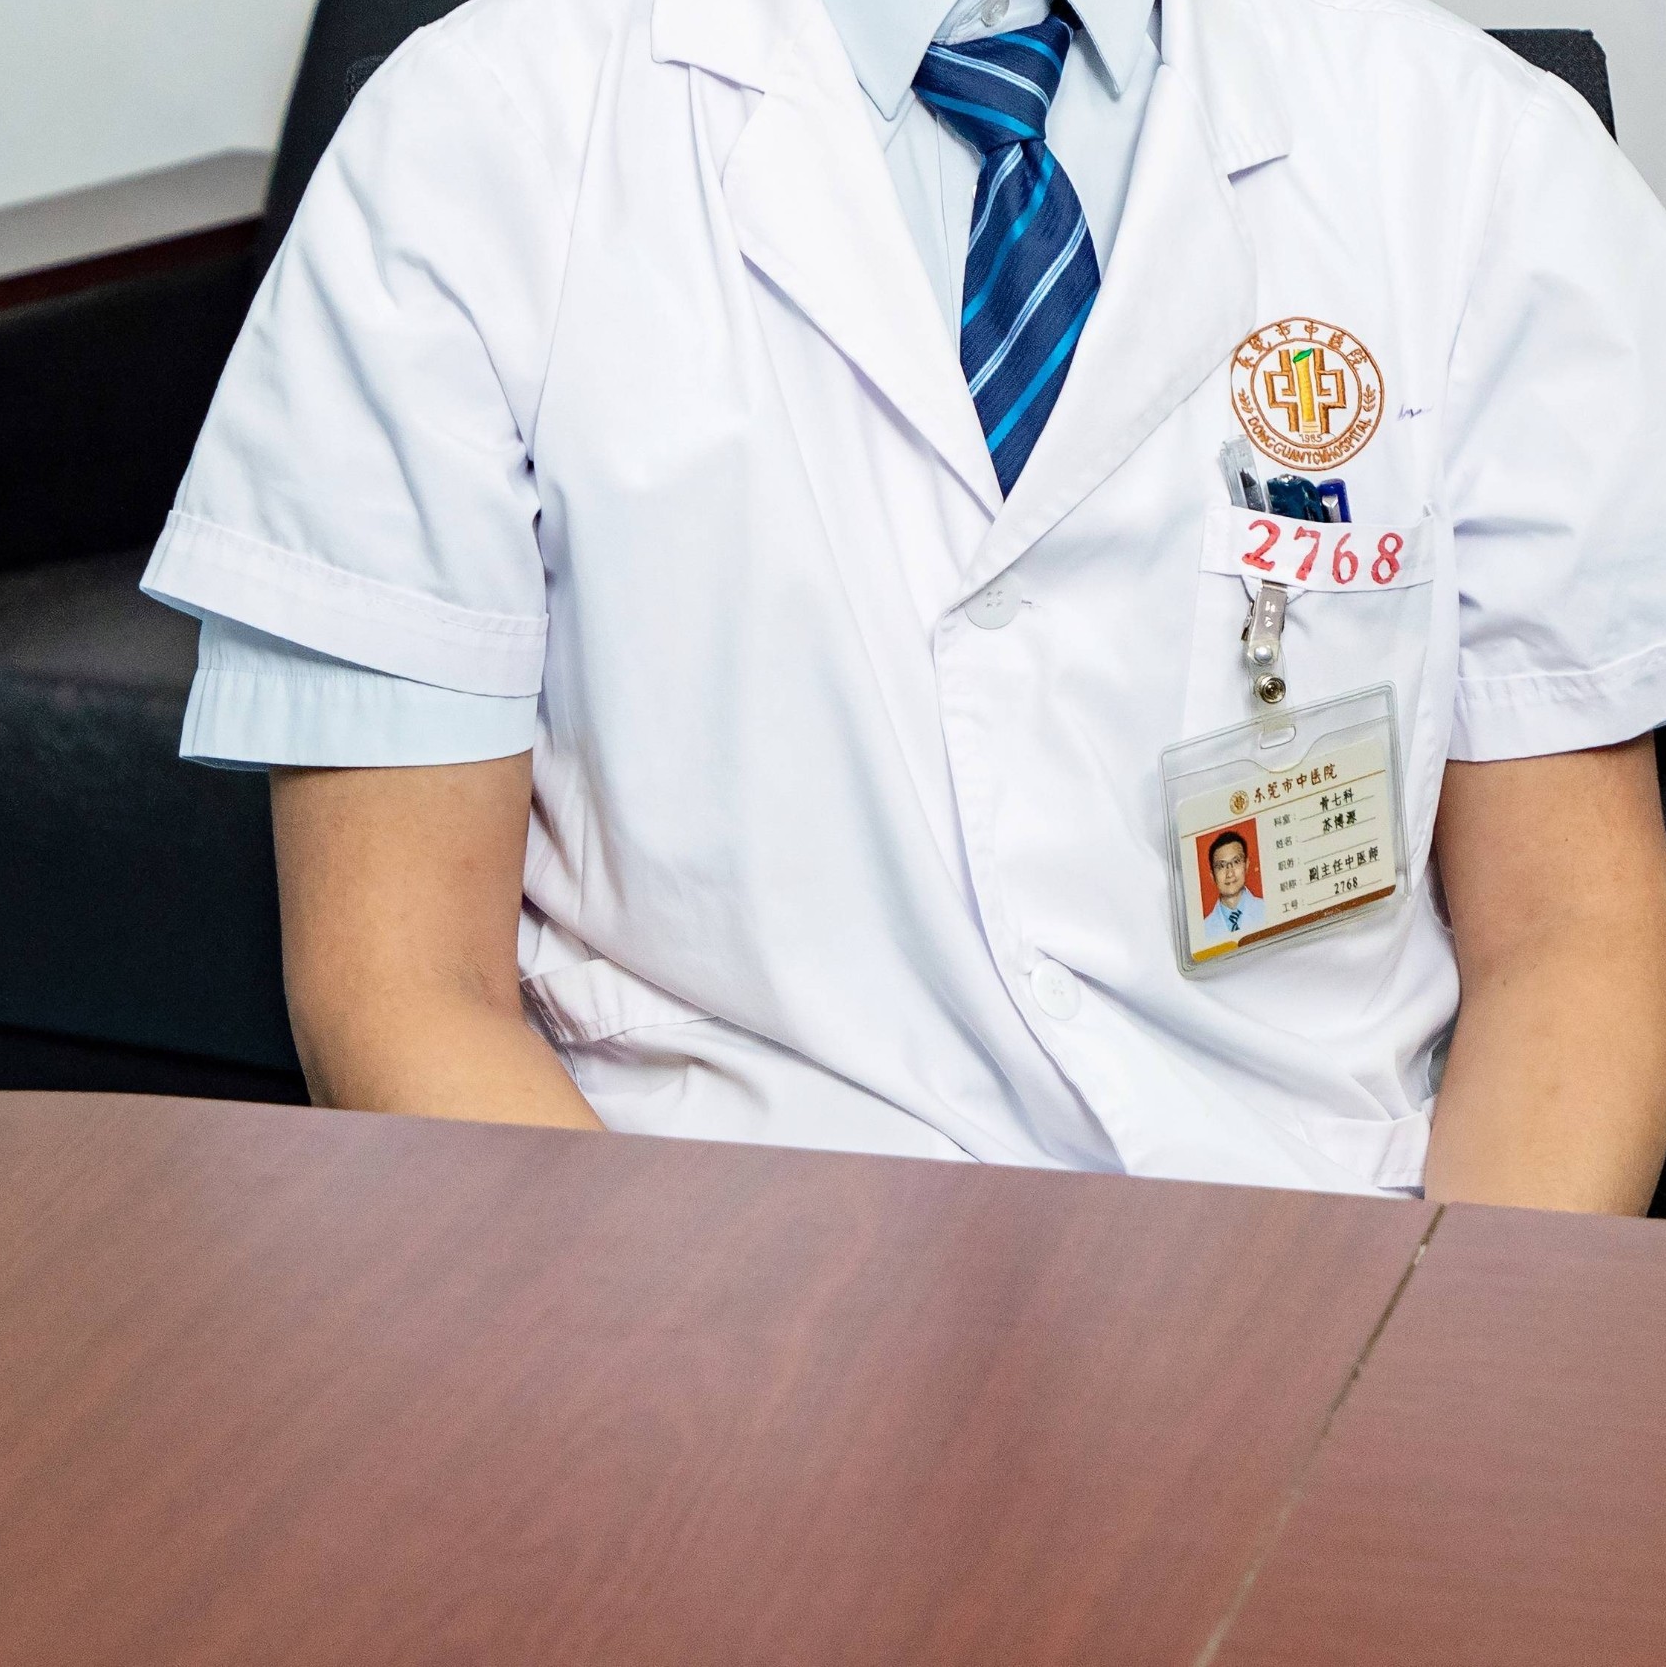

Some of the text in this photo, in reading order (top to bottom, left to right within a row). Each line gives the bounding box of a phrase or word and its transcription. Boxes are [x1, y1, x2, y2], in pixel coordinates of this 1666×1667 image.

[1242, 520, 1404, 584] 2768
[1253, 763, 1338, 804] 东莞市中医院
[1308, 846, 1379, 882] 副主任中医师
[1334, 876, 1358, 895] 2768
